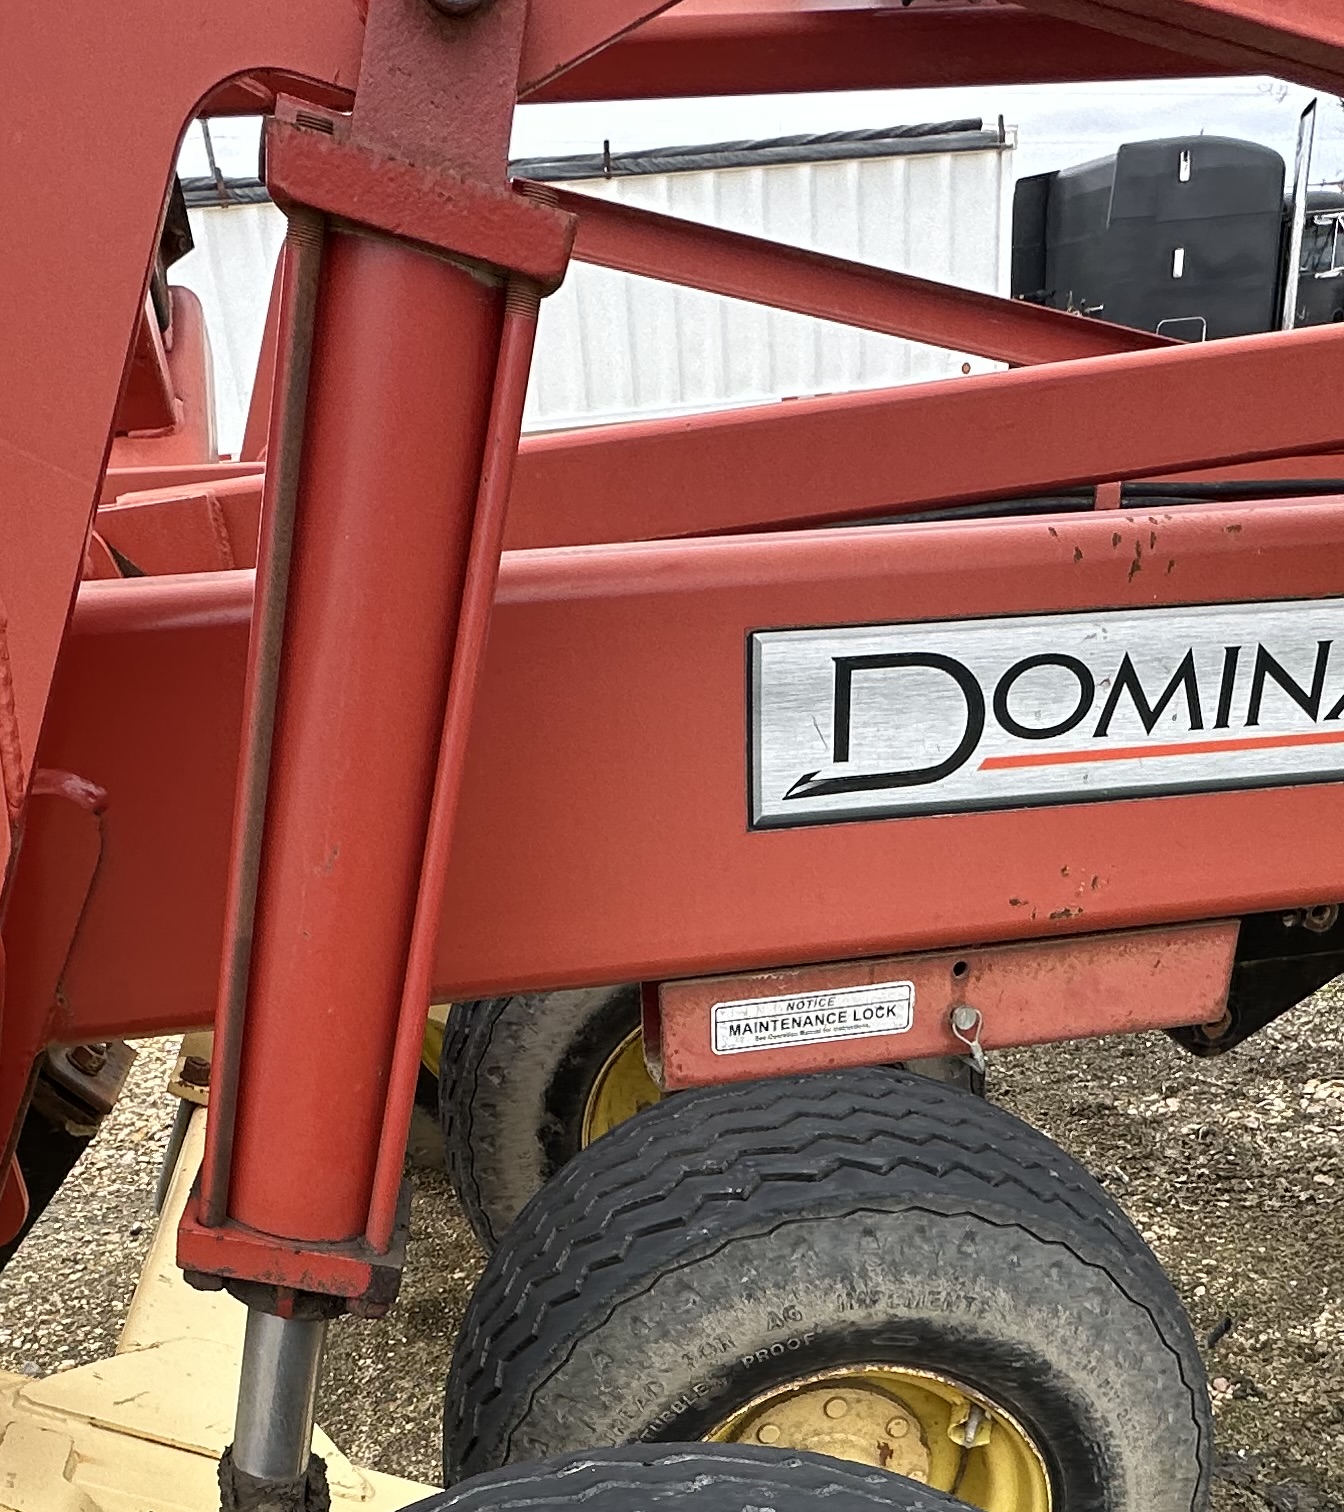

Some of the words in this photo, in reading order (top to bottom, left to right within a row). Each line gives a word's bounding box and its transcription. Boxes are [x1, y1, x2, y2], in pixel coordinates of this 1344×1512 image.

[728, 1010, 848, 1038] MAINTENANCE
[852, 1004, 897, 1022] LOCK
[786, 996, 837, 1012] NOTICE
[638, 1382, 710, 1443] TUBBLE
[741, 1331, 818, 1369] PROOF
